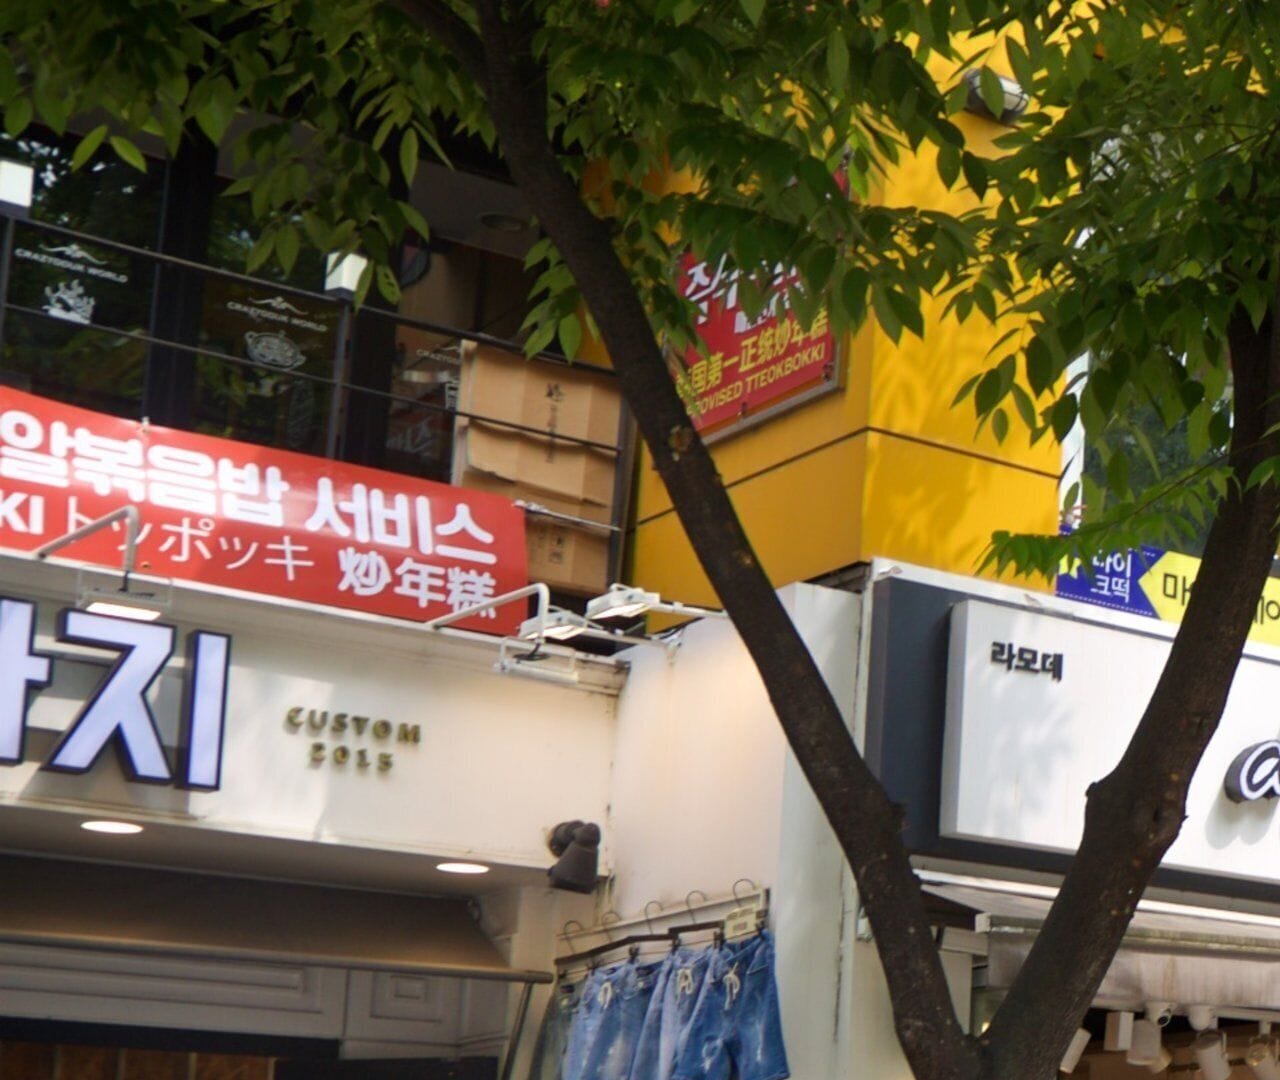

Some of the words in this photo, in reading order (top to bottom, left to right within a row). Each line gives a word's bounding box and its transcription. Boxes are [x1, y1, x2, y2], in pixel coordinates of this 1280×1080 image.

[747, 343, 826, 393] TTEOKBOKKI
[305, 477, 497, 564] 서비스
[338, 547, 497, 619] 炒年糕
[991, 641, 1064, 681] 라모데
[286, 706, 422, 746] CUSTOM
